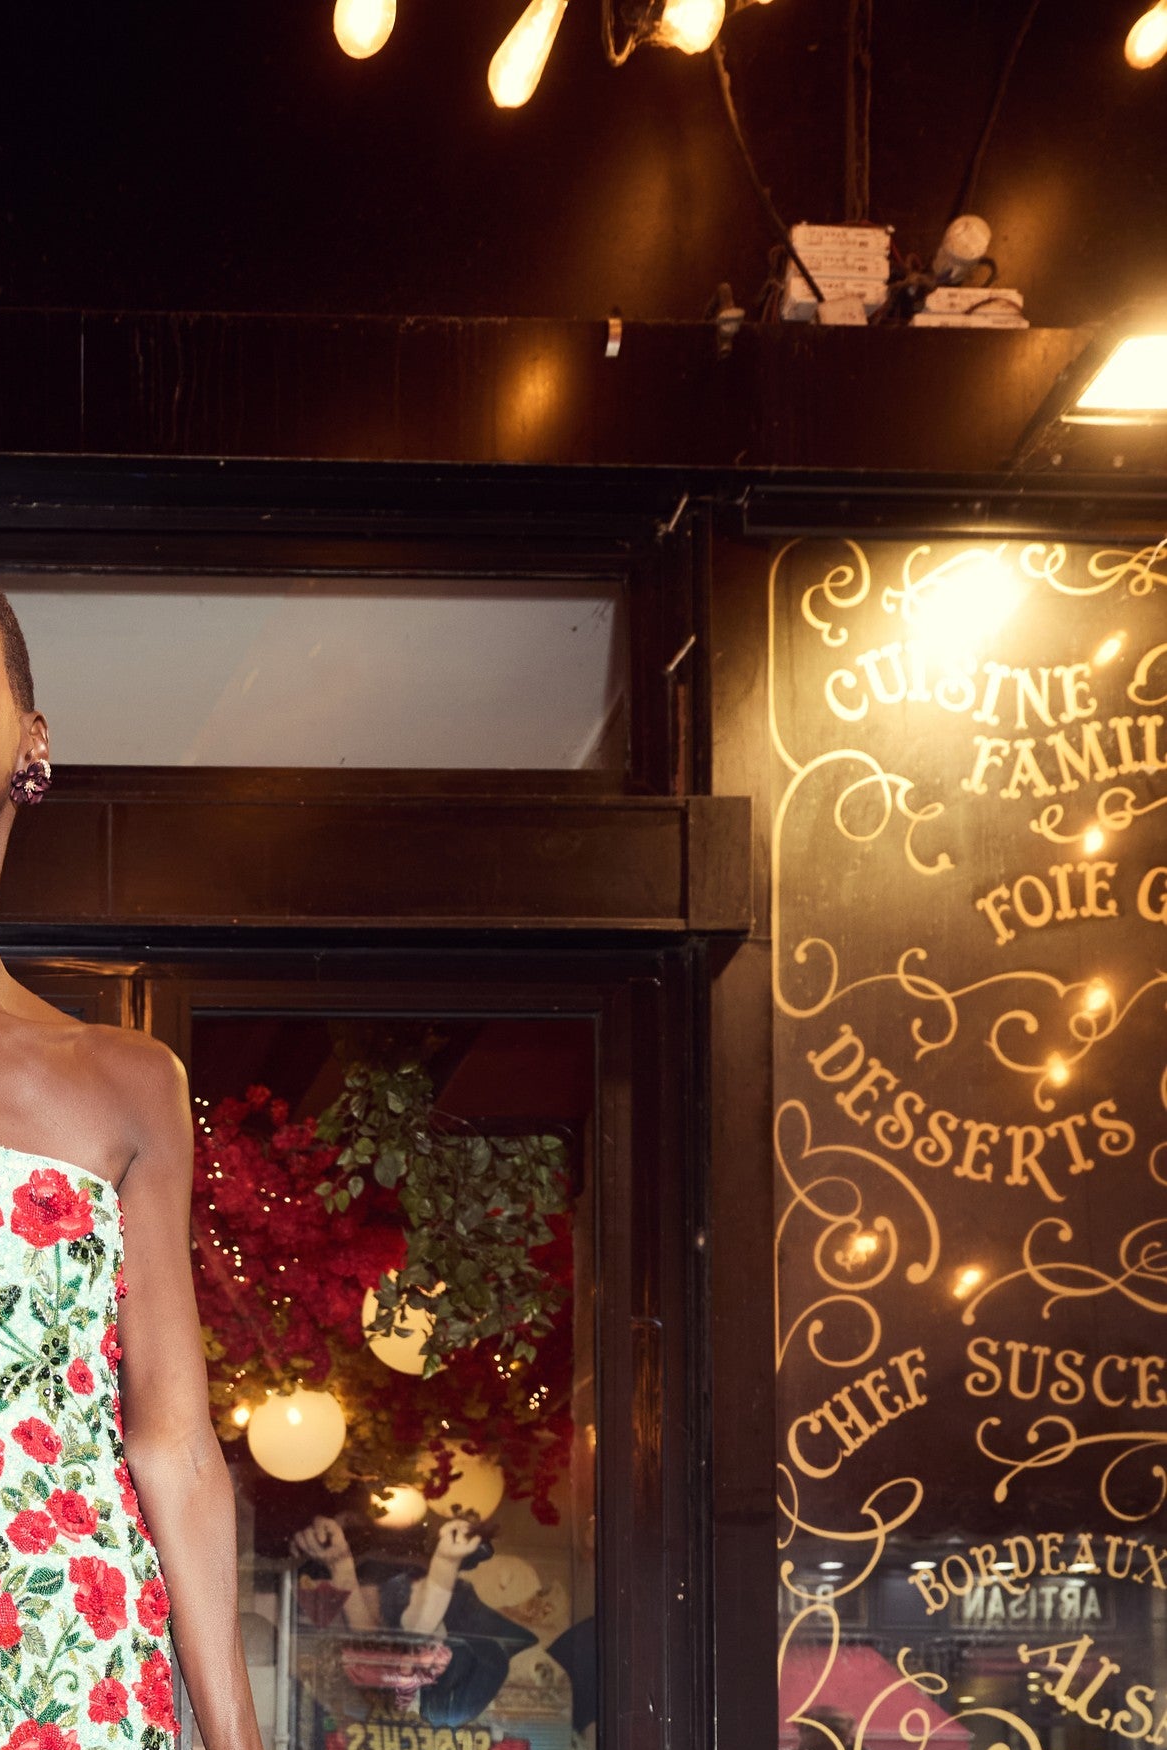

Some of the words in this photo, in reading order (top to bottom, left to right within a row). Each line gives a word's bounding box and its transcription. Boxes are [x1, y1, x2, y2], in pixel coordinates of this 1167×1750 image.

[976, 860, 1118, 946] FOIE
[806, 1023, 1136, 1203] DESSERTS
[787, 1346, 929, 1479] CHEF
[964, 1336, 1167, 1409] SUSCE
[908, 1532, 1167, 1616] BORDEAUX
